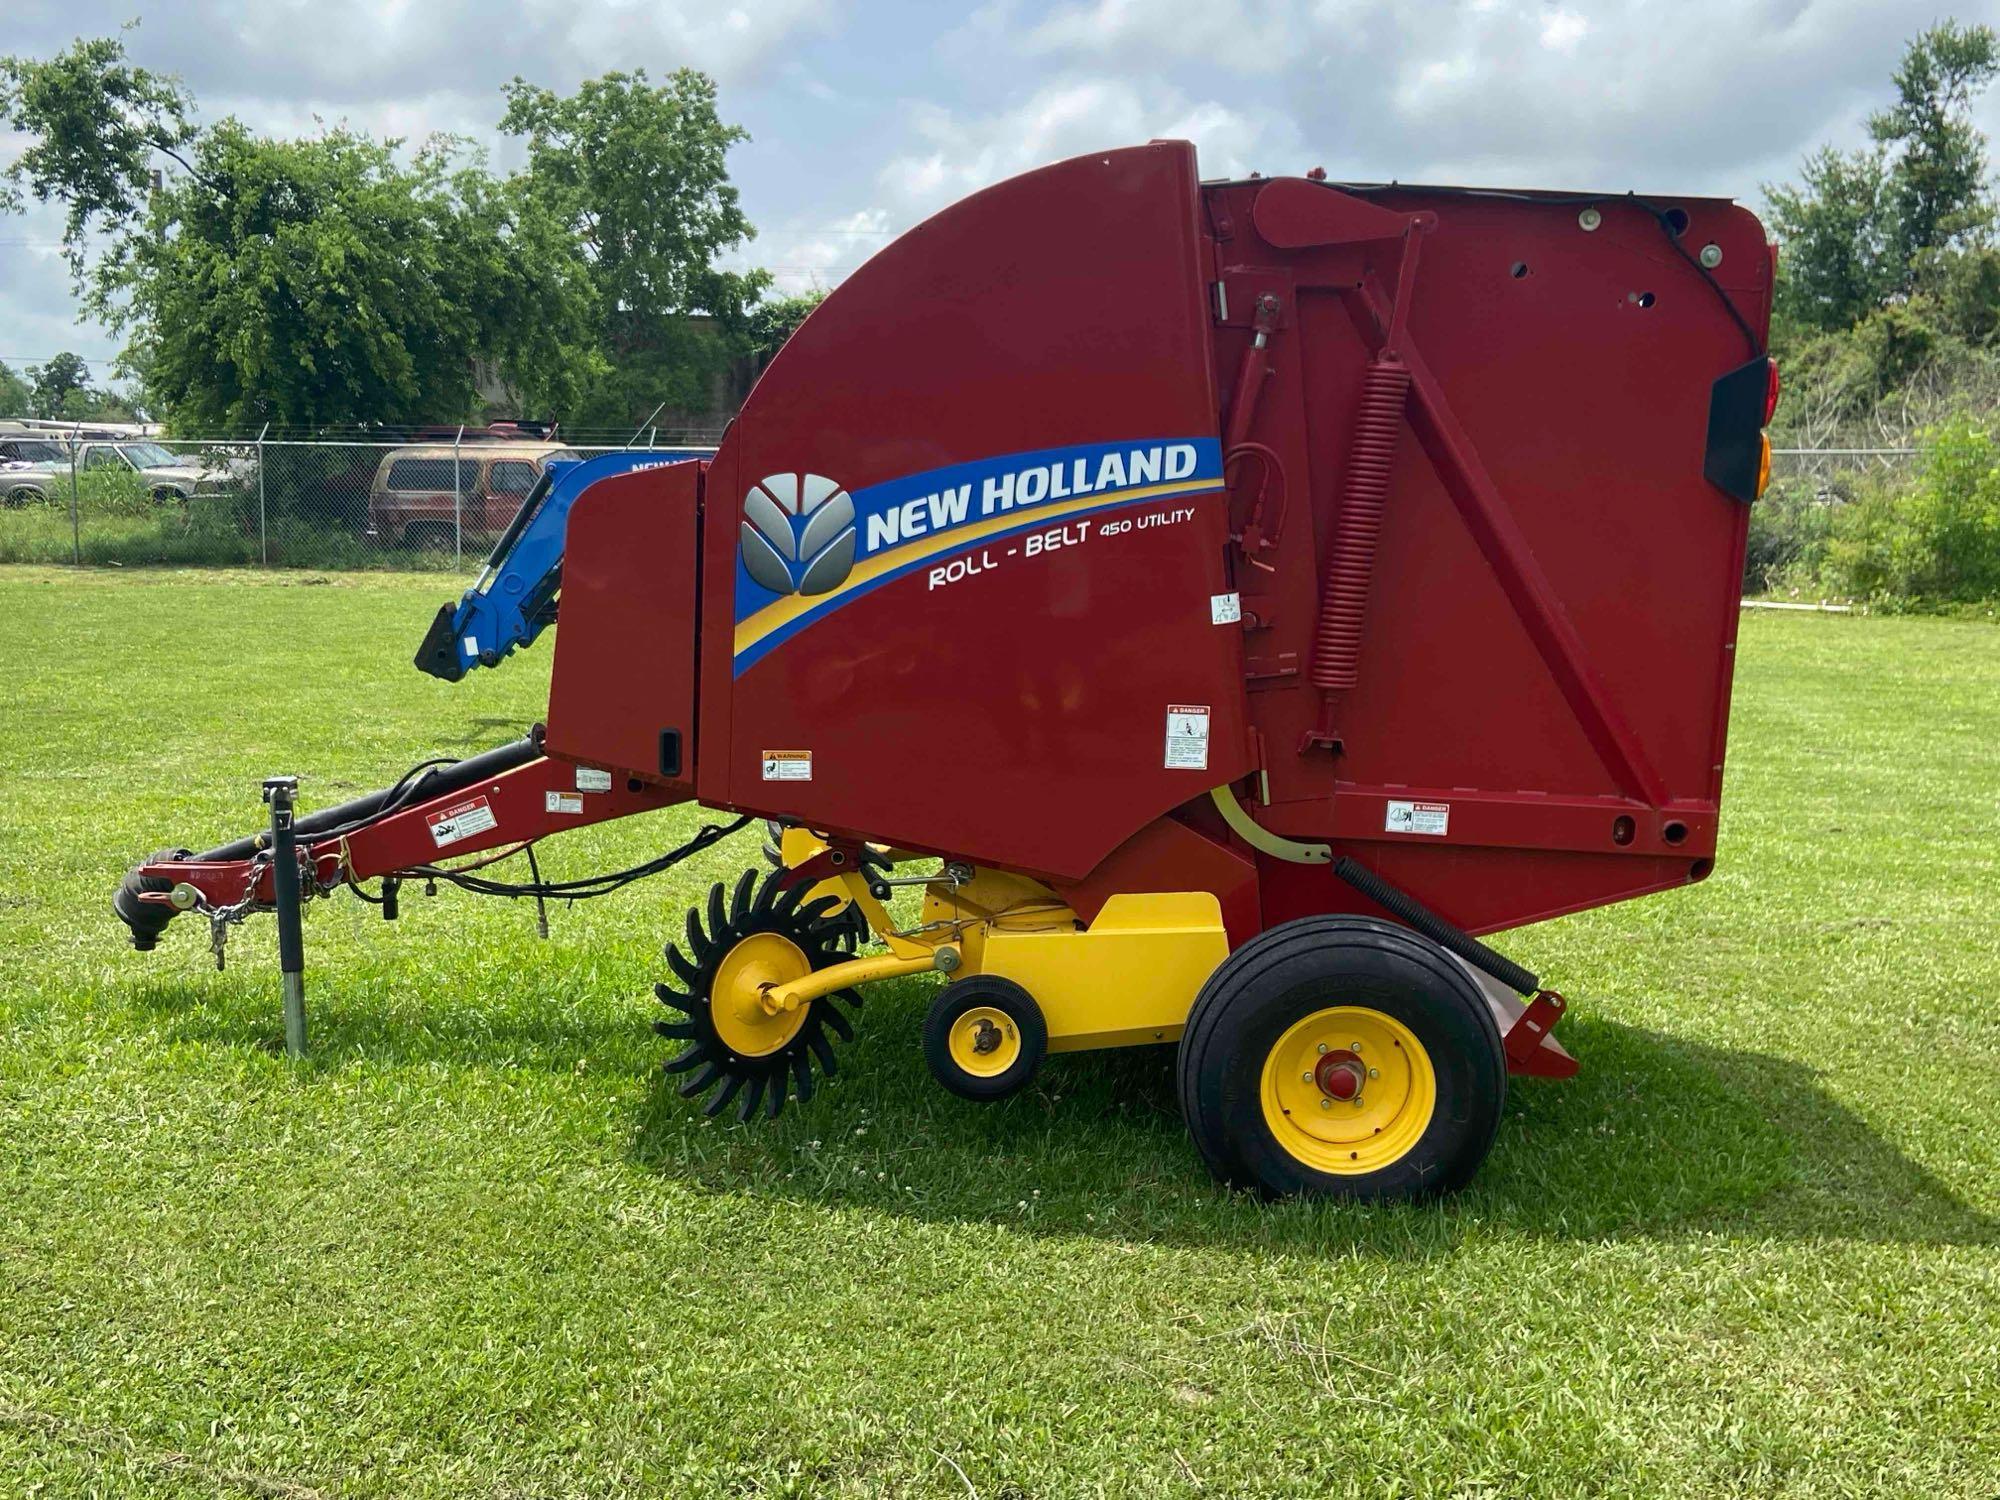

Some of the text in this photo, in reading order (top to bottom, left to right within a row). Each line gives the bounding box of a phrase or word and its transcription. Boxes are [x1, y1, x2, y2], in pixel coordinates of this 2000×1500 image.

[867, 444, 1197, 552] NEW HOLLAND
[928, 552, 998, 591] ROLL
[1025, 521, 1091, 557] BELT
[1099, 519, 1132, 537] 450
[1137, 508, 1196, 530] UTILITY
[448, 802, 476, 817] DANGER
